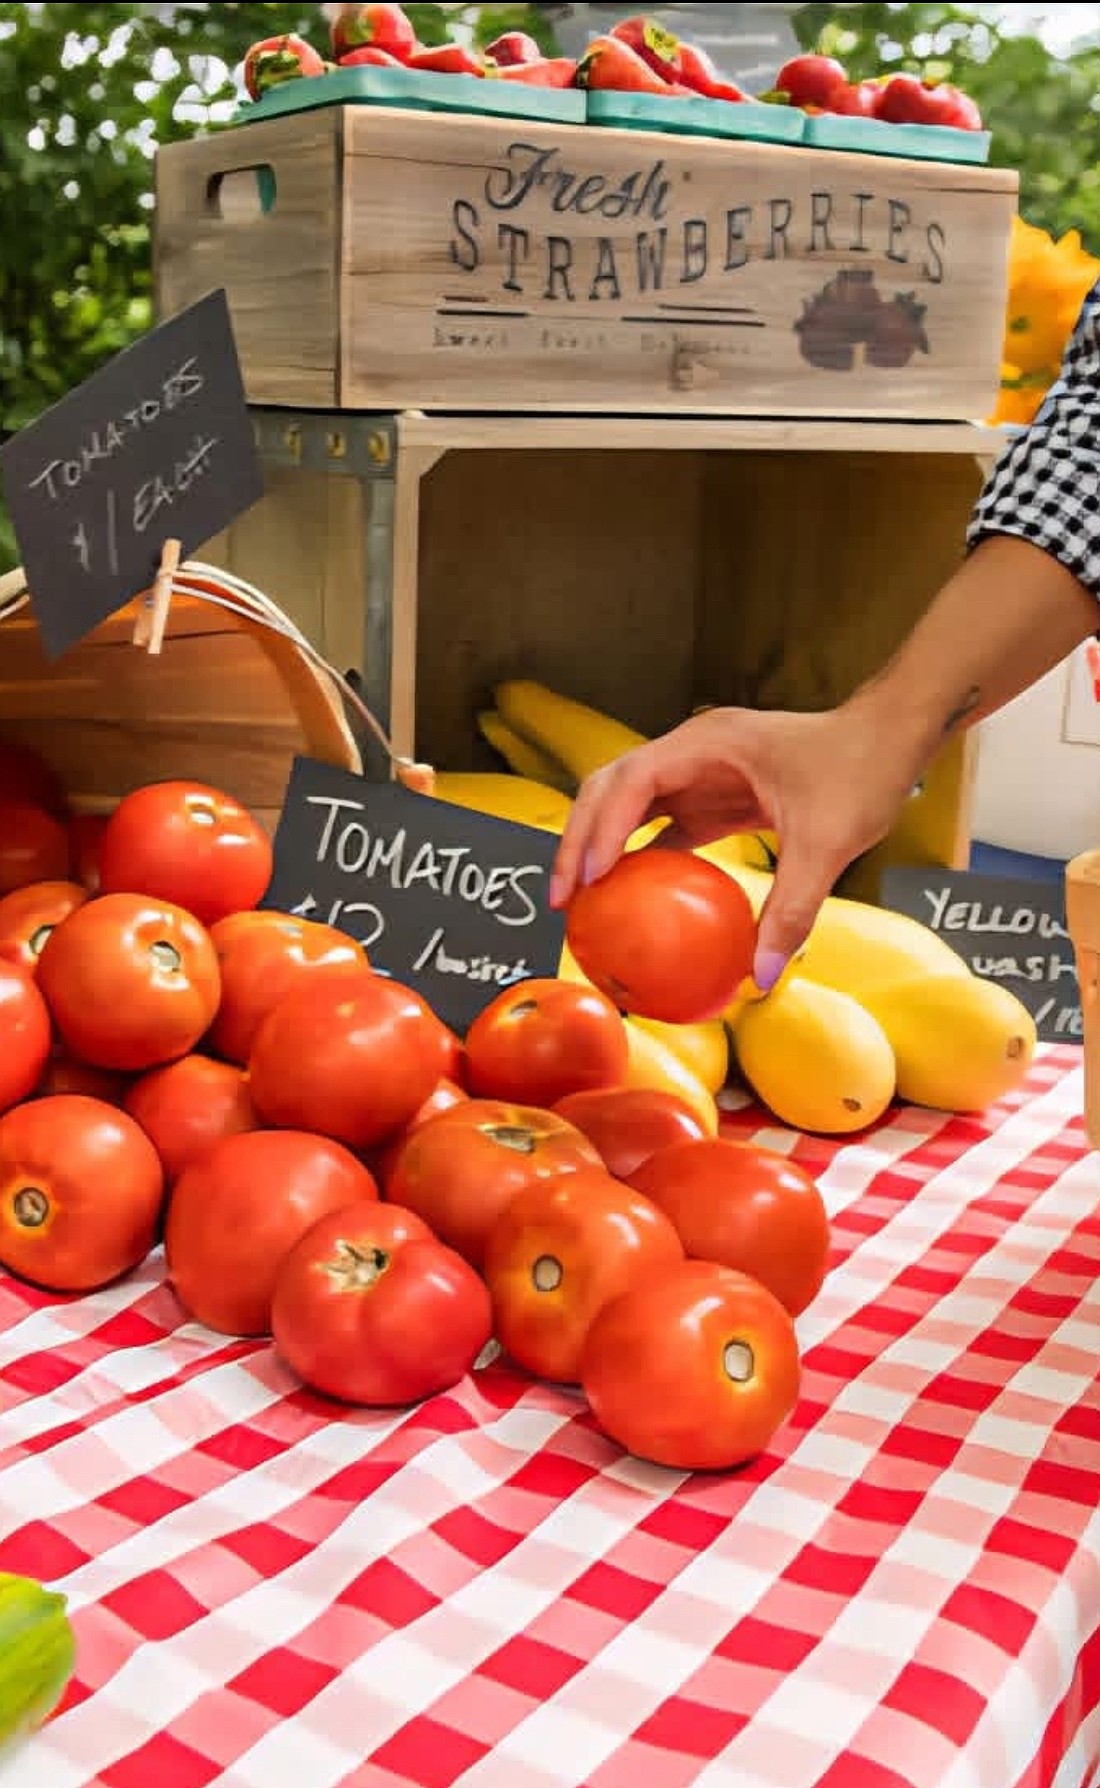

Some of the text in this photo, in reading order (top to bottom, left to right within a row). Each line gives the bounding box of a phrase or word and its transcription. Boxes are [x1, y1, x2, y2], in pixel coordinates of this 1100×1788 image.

[484, 142, 672, 219] Fresh
[449, 192, 947, 301] STRAWBERRIES
[28, 356, 204, 498] TOMATOES
[306, 796, 544, 926] TOMATOES
